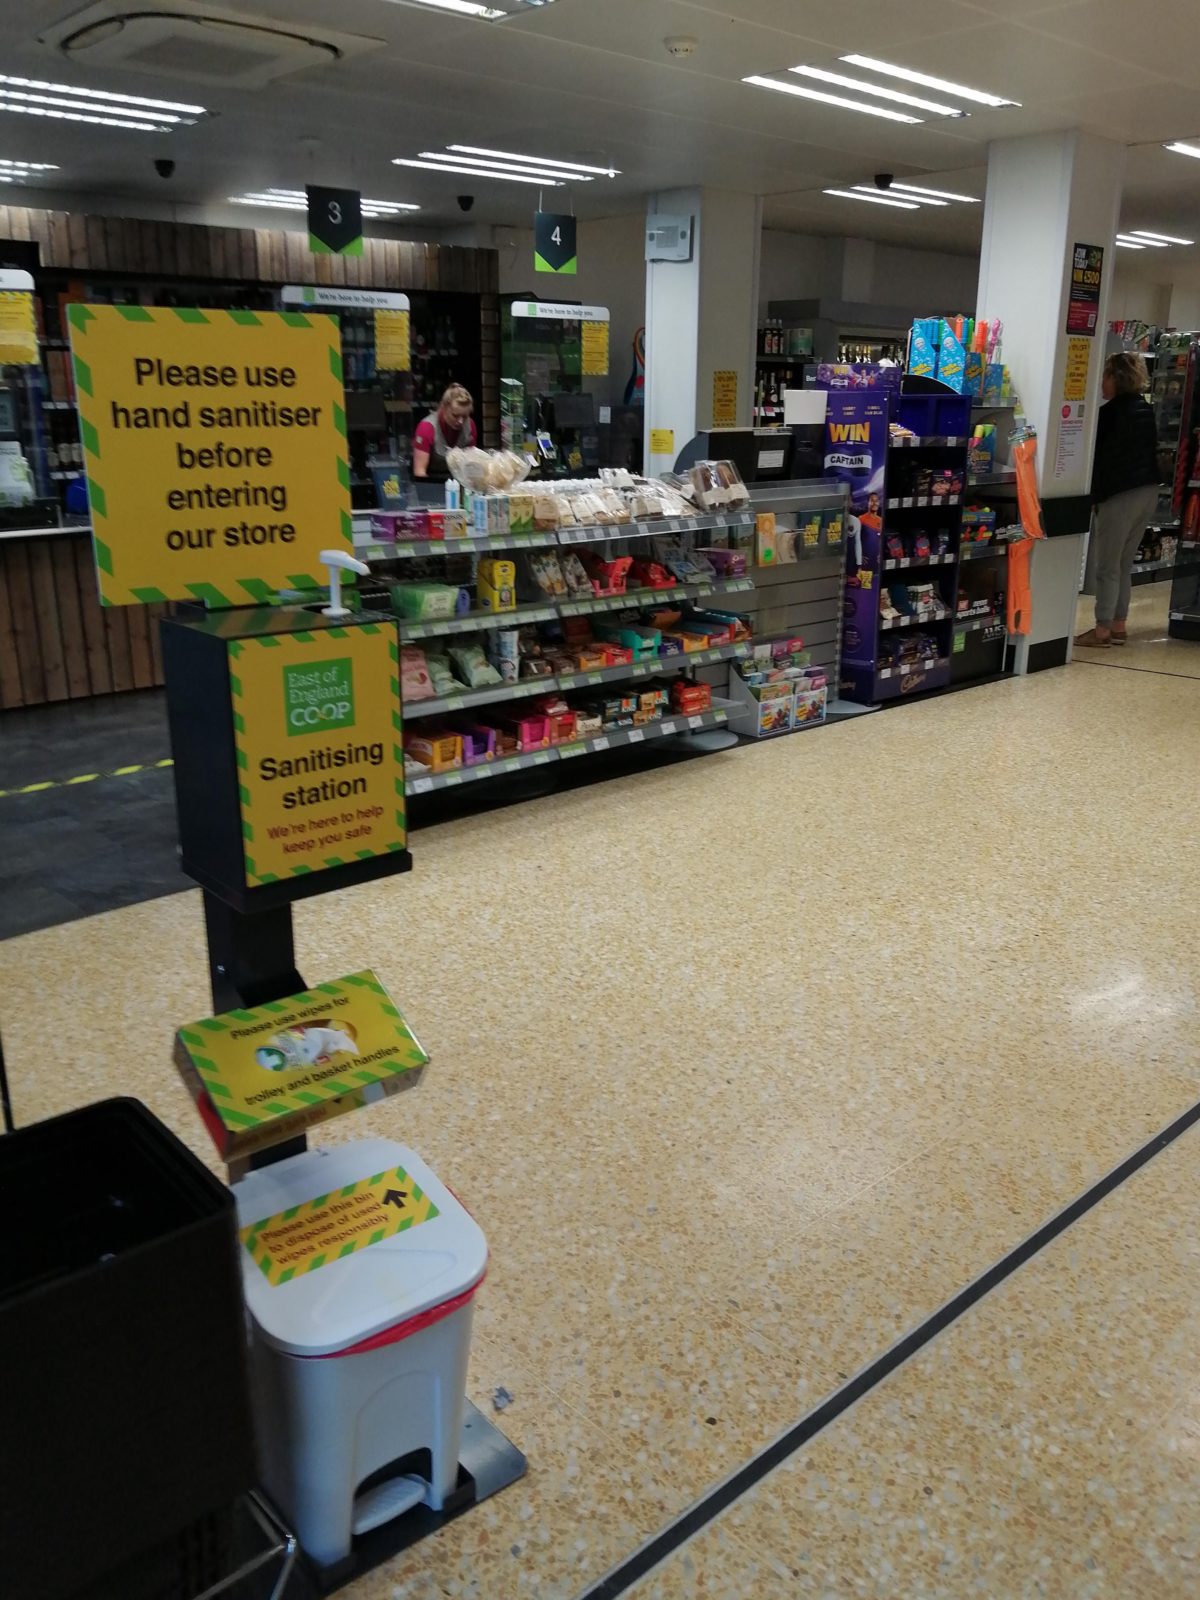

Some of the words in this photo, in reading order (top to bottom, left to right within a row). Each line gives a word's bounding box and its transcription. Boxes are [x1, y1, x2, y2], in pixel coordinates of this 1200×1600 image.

[328, 200, 343, 225] 3
[550, 225, 562, 246] 4
[338, 293, 352, 301] here
[361, 295, 376, 303] help
[134, 358, 237, 387] Please
[244, 366, 297, 388] use
[111, 400, 191, 429] hand
[199, 400, 322, 428] sanitiser
[828, 421, 870, 443] WIN
[176, 441, 273, 469] before
[830, 455, 864, 465] CAPTAIN
[167, 480, 287, 512] entering
[165, 528, 216, 551] our
[224, 521, 296, 547] store
[287, 672, 320, 687] East
[322, 666, 338, 683] of
[289, 680, 350, 705] England
[259, 742, 384, 782] Sanitising
[282, 777, 367, 809] station
[267, 823, 306, 839] We're
[308, 816, 339, 830] here
[341, 812, 354, 823] to
[356, 805, 384, 820] help
[282, 839, 315, 854] keep
[318, 832, 343, 849] you
[345, 824, 372, 840] safe
[230, 1020, 274, 1040] Please
[274, 1014, 297, 1026] use
[297, 1001, 332, 1019] wipes
[332, 996, 350, 1009] for
[244, 1086, 286, 1106] trolley
[287, 1075, 310, 1091] and
[312, 1062, 352, 1082] basket
[353, 1045, 401, 1067] handles
[260, 1220, 305, 1242] Please
[305, 1211, 329, 1224] use
[329, 1201, 353, 1214] this
[353, 1191, 375, 1204] bin
[268, 1243, 283, 1254] to
[285, 1221, 335, 1247] dispose
[336, 1214, 350, 1226] of
[352, 1201, 382, 1219] used
[276, 1244, 316, 1265] wipes
[318, 1213, 389, 1248] responsibly
